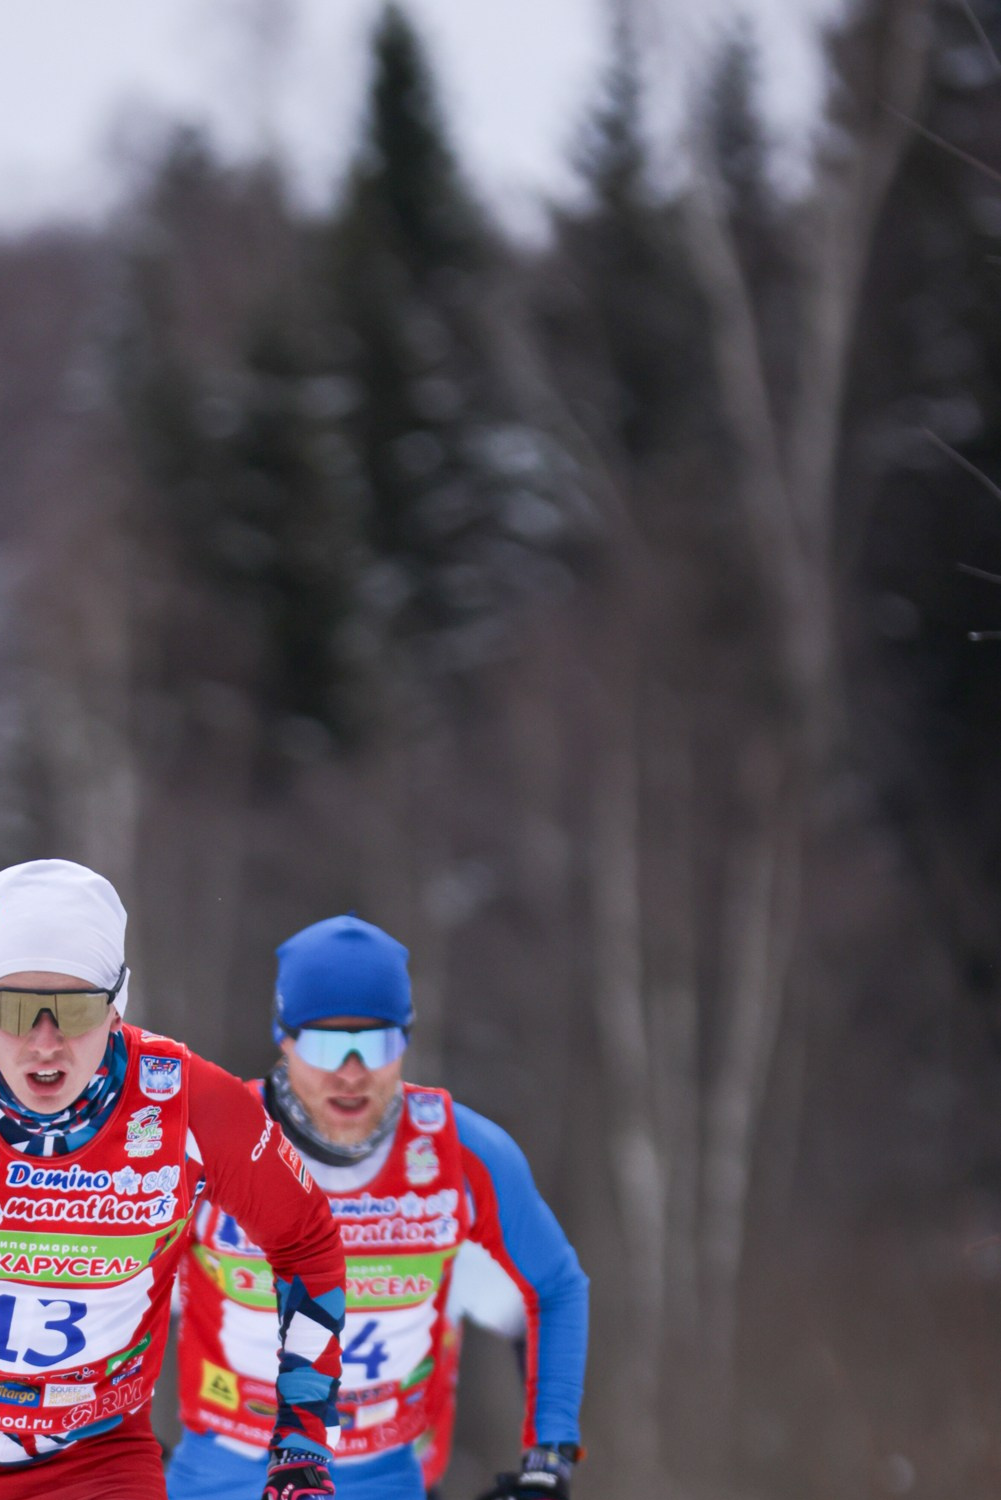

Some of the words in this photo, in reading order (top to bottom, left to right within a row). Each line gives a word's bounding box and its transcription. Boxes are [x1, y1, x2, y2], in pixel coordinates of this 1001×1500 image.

[8, 1163, 110, 1190] Demino
[6, 1198, 151, 1221] marathon
[346, 1277, 431, 1296] РУСЕЛЬ
[341, 1320, 388, 1379] 4
